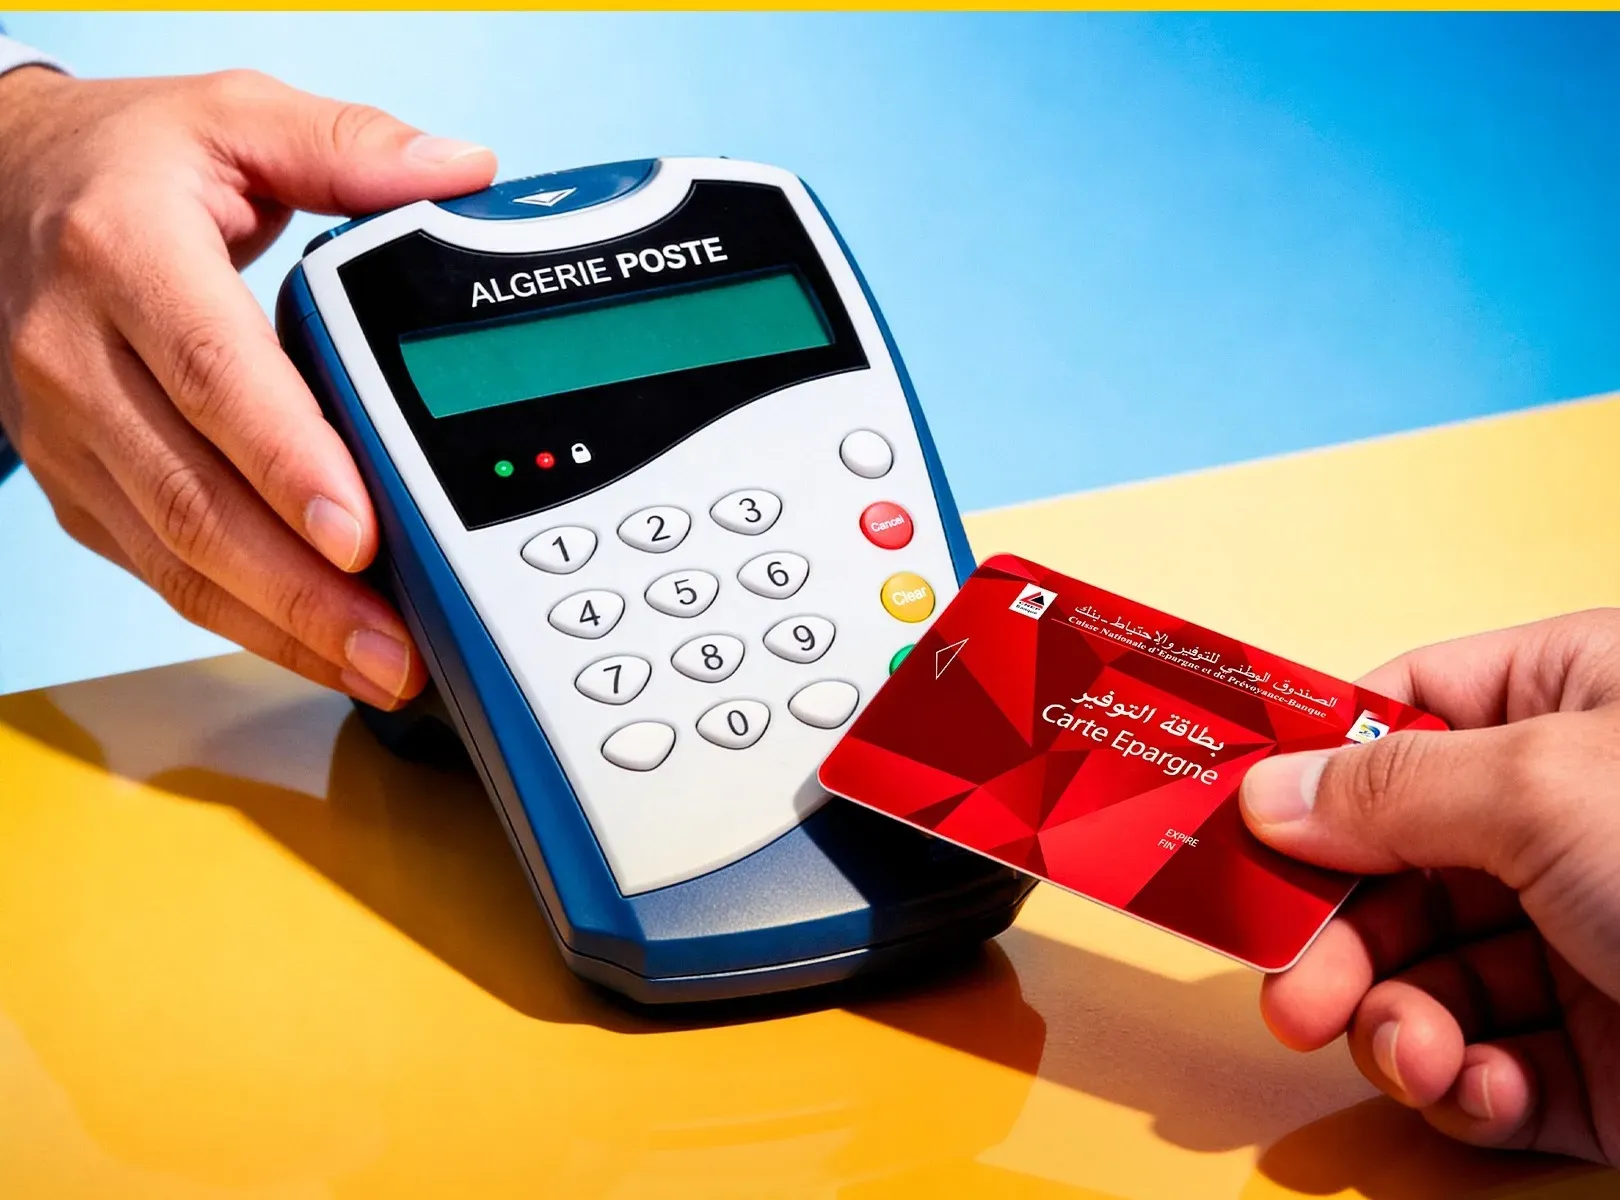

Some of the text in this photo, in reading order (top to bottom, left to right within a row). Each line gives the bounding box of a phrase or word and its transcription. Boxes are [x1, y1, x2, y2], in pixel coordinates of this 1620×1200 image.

[471, 236, 729, 308] ALGERIE POSTE
[738, 497, 762, 523] 3
[870, 514, 905, 533] Cancel
[646, 515, 671, 542] 2
[552, 535, 571, 563] 1
[766, 561, 790, 587] 6
[674, 578, 698, 605] 5
[891, 586, 928, 606] Clear
[579, 599, 601, 627] 4
[1074, 605, 1101, 622] بنك
[793, 624, 816, 651] 9
[1068, 616, 1099, 632] Caisse
[1099, 627, 1147, 650] Nationale
[1201, 666, 1212, 675] et
[1213, 669, 1226, 680] de
[701, 643, 724, 671] 8
[1170, 646, 1221, 664] للتوفير
[603, 664, 624, 695] 7
[1219, 664, 1272, 683] الوطني
[1272, 680, 1339, 708] الصندوق
[726, 709, 749, 737] 0
[1070, 690, 1225, 757] بطاقة التوفير
[1042, 704, 1218, 785] Carte Epargne
[1157, 838, 1176, 851] FIN
[1165, 828, 1200, 848] EXPIRE
